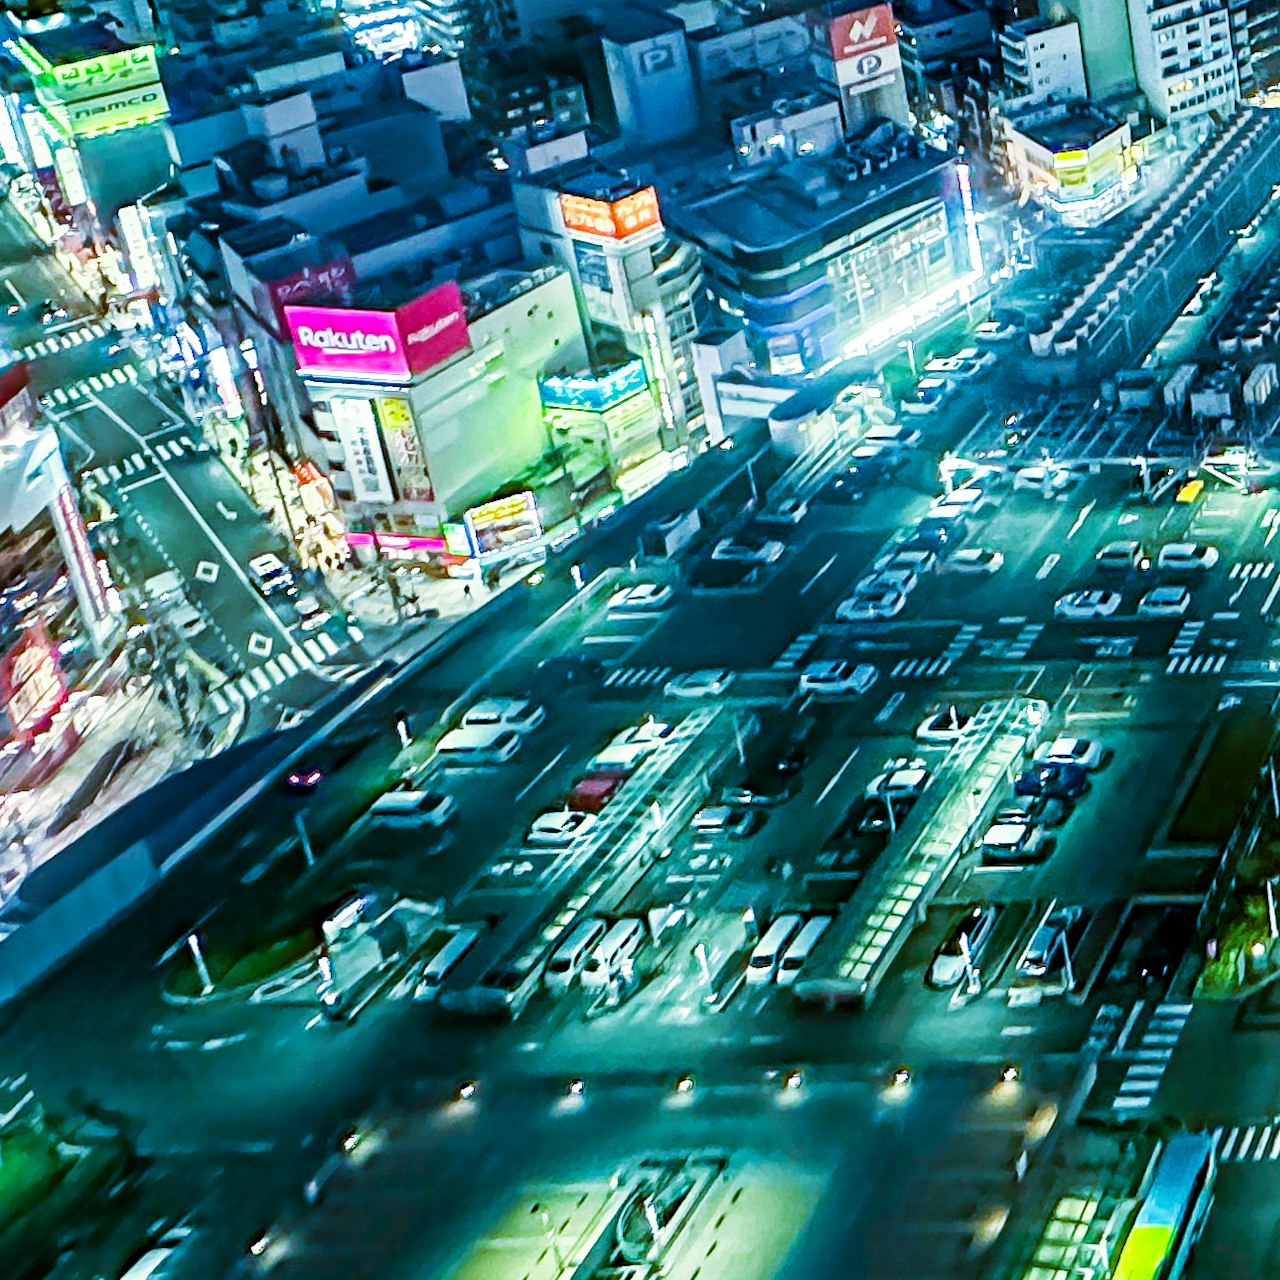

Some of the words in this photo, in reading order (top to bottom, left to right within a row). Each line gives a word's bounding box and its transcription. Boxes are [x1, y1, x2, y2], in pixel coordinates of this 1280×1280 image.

[643, 50, 668, 73] P
[74, 92, 158, 120] namco
[297, 325, 396, 354] Rakuten
